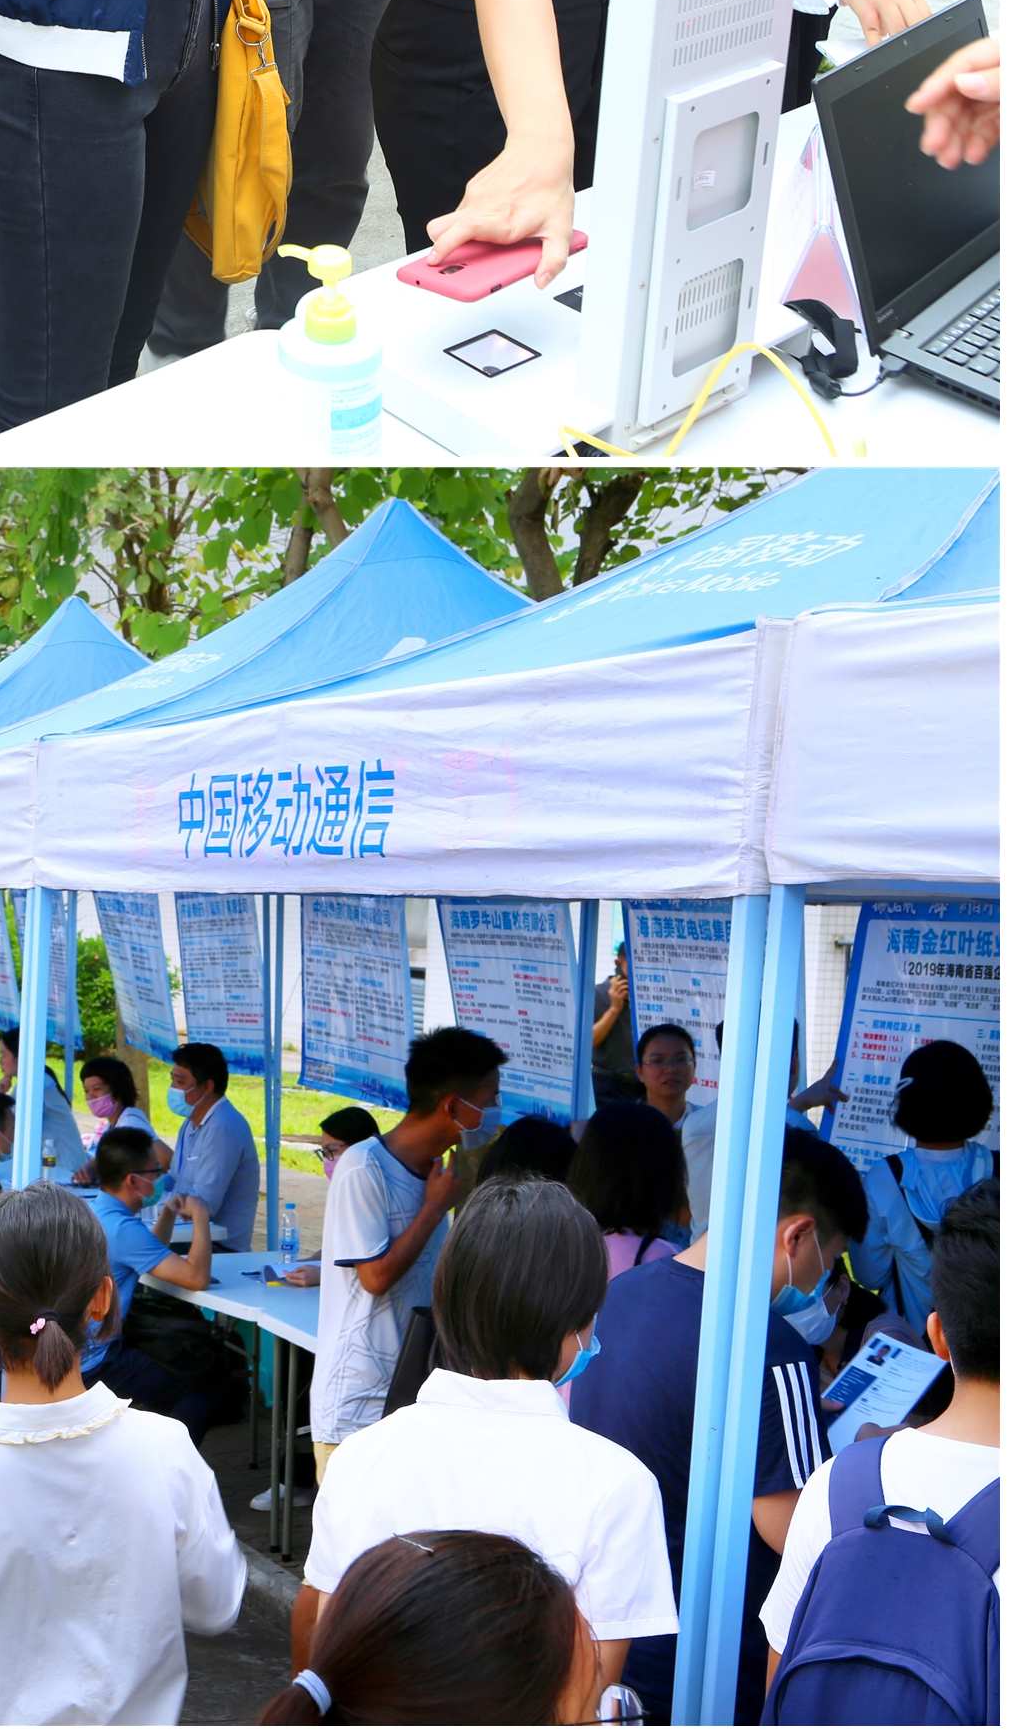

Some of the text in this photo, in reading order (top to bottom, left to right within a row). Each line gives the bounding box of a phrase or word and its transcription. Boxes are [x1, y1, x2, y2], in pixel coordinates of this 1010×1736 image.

[177, 758, 395, 859] 中国移动通信
